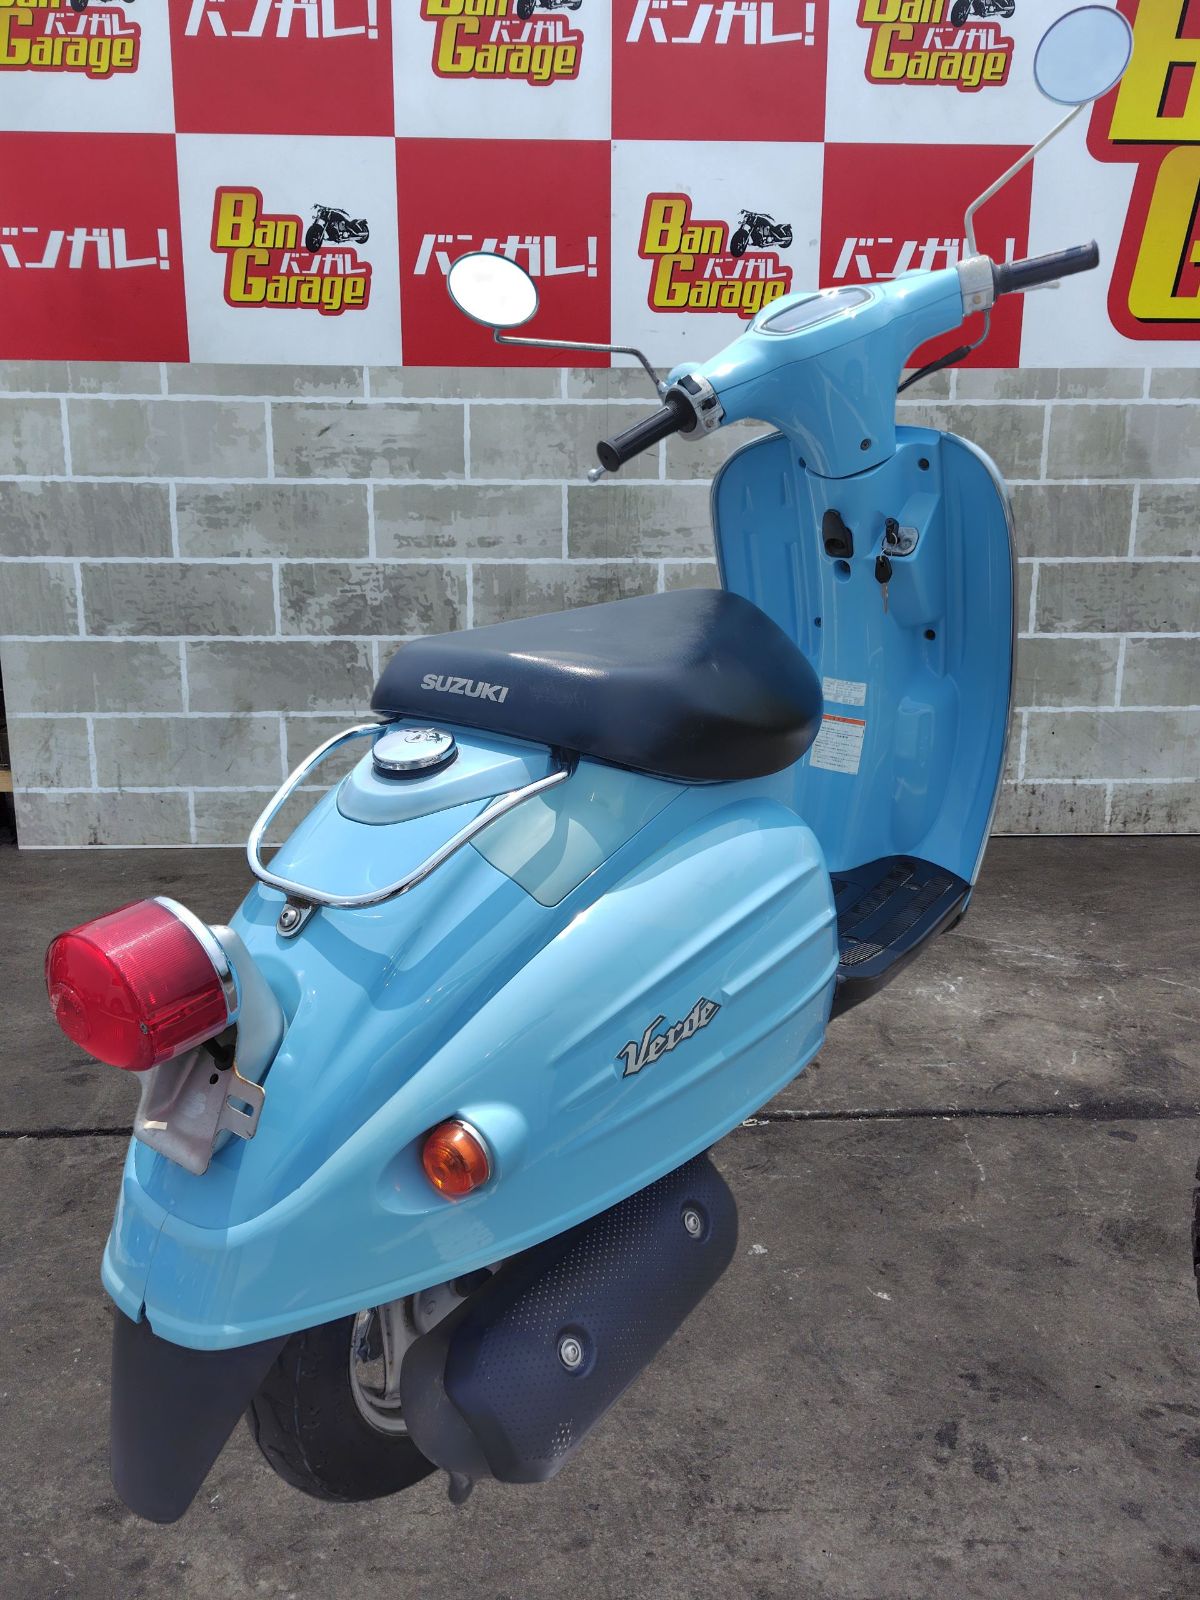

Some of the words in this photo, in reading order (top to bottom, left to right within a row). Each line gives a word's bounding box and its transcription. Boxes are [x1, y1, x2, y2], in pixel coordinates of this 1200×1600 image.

[0, 8, 135, 74] Garage
[44, 12, 135, 36] バンガレ
[438, 16, 577, 81] Garage
[489, 20, 578, 43] バンガレ
[922, 27, 1009, 50] バンガレ
[870, 23, 1007, 87] Garage
[216, 192, 299, 249] Ban
[644, 199, 725, 255] Ban
[229, 248, 366, 311] Garage
[279, 252, 367, 275] バンガレ
[703, 258, 787, 279] バンガレ
[420, 673, 509, 704] SUZUKI
[615, 996, 722, 1079] Verde
